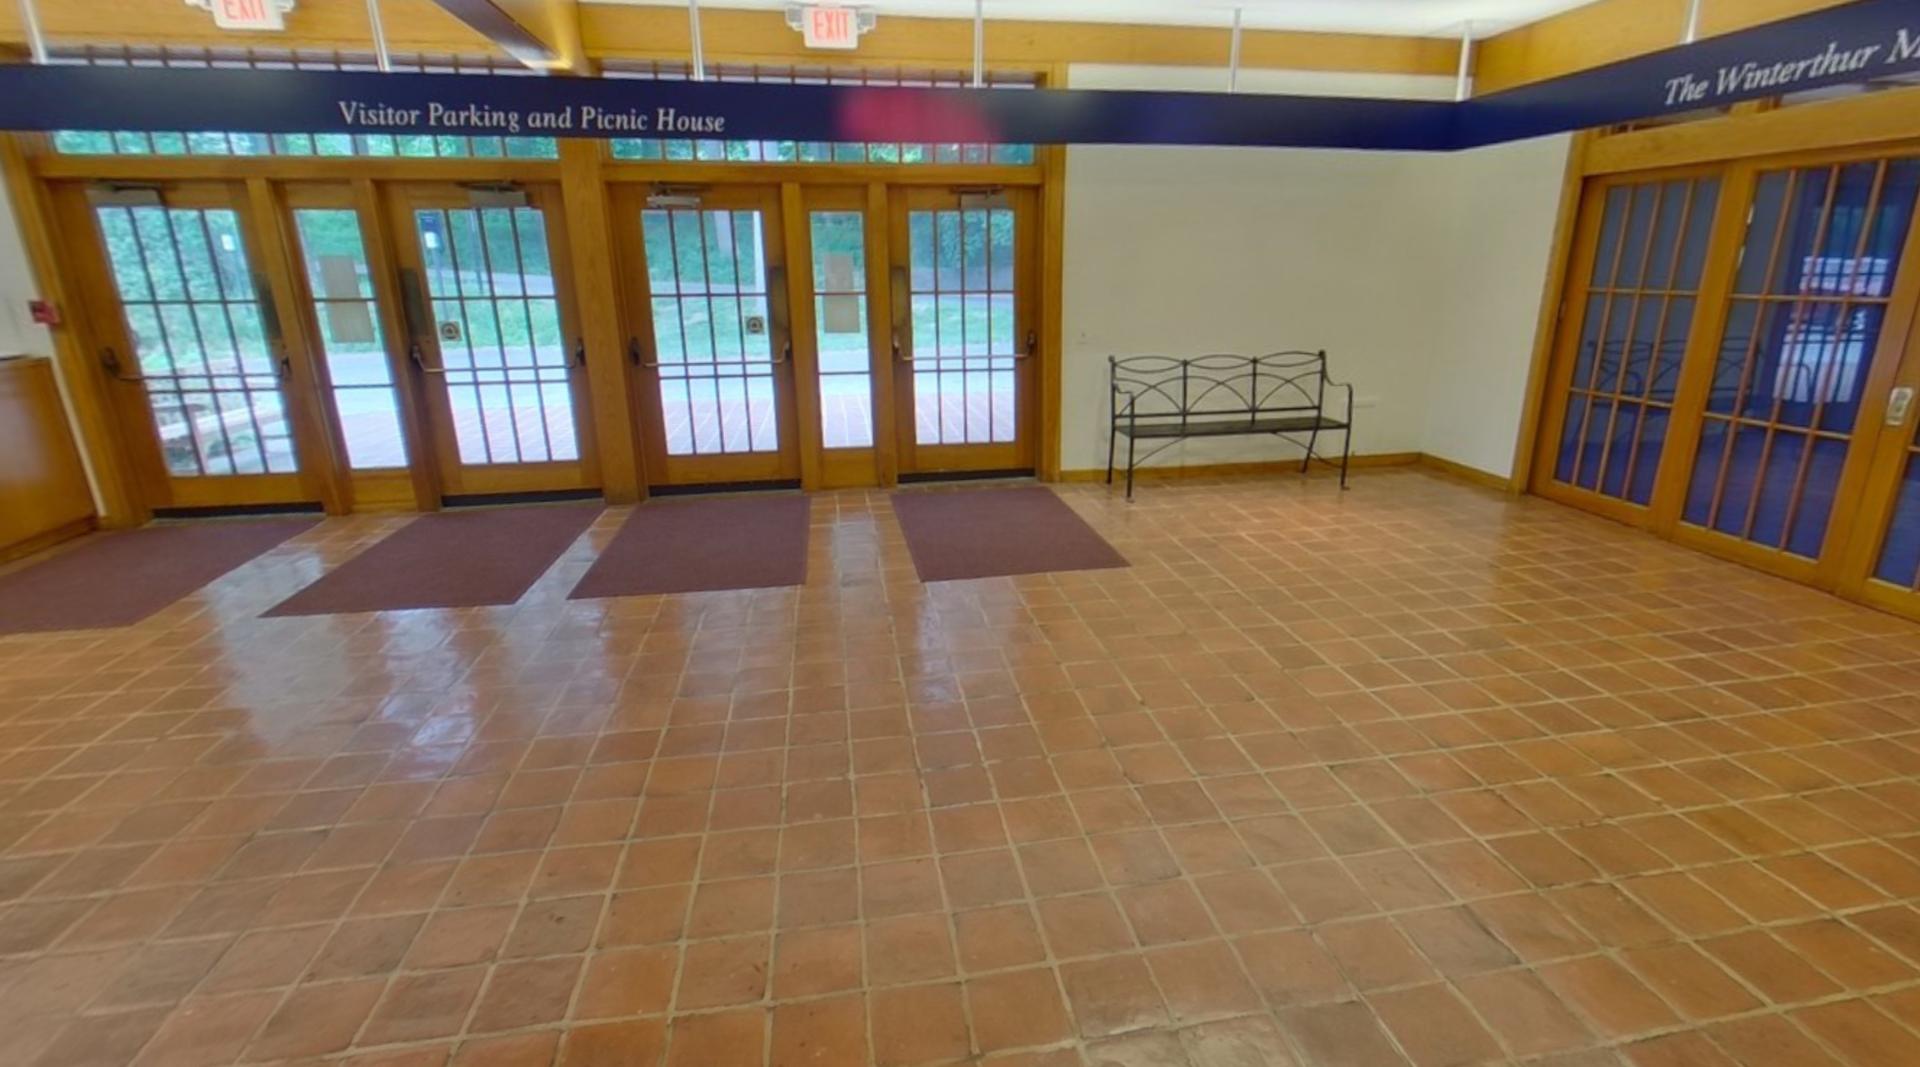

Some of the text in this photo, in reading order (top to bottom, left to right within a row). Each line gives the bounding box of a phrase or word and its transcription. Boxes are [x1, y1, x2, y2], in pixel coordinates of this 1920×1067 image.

[813, 9, 849, 41] EXIT
[1664, 72, 1709, 105] The
[1715, 41, 1881, 96] Winterthur
[338, 101, 726, 133] Visitor Parking and Picnic House
